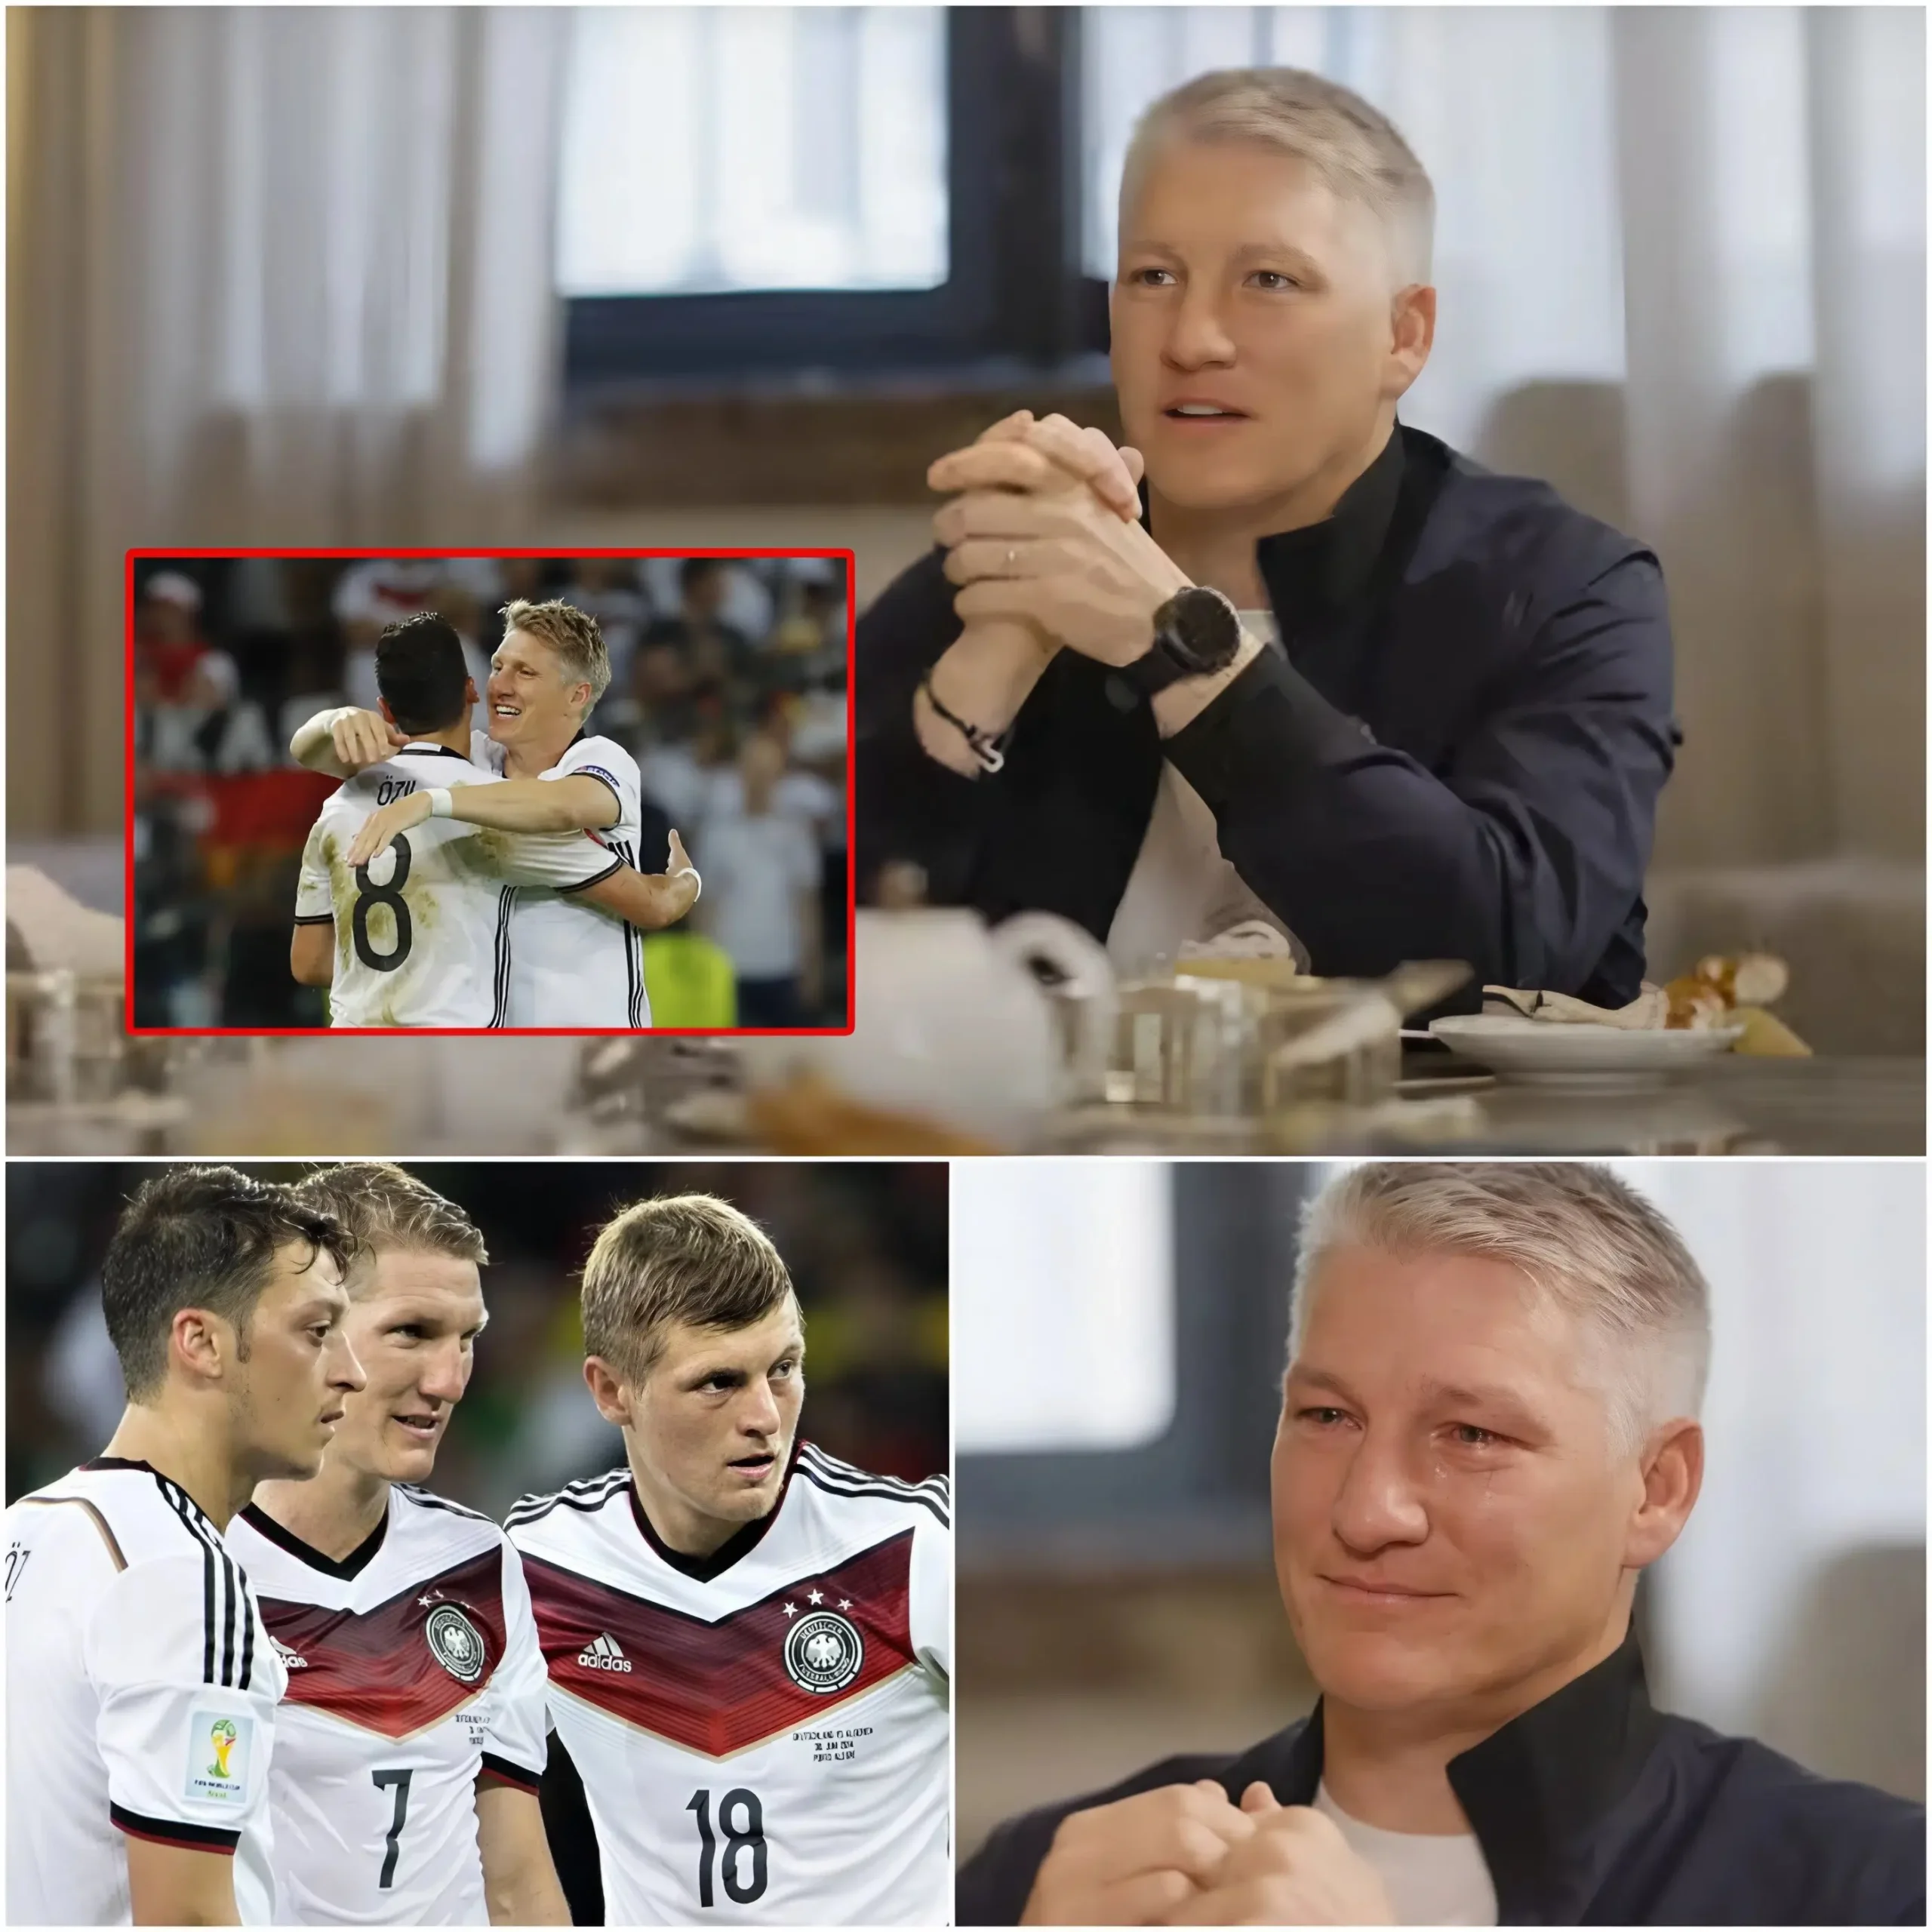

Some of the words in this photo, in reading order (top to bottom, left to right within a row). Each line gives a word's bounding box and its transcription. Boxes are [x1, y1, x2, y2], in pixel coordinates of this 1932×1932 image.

[353, 832, 412, 972] 8
[578, 1654, 632, 1672] adidas
[372, 1769, 414, 1888] 7
[685, 1788, 768, 1908] 18
